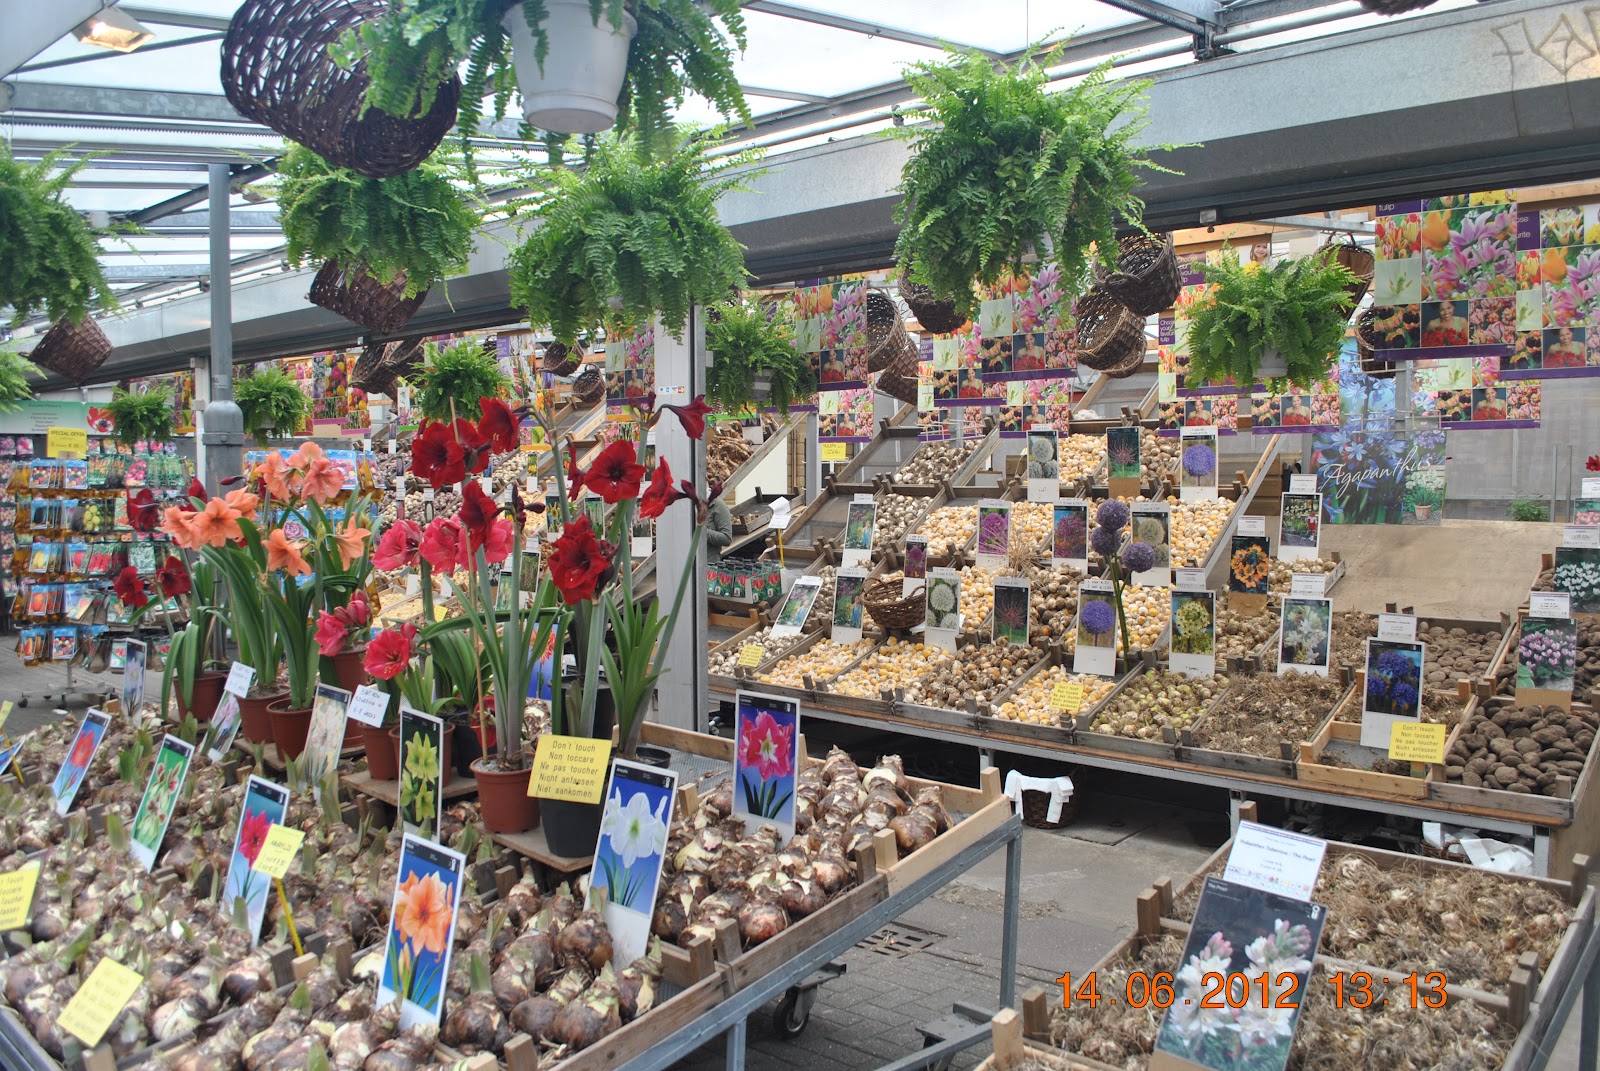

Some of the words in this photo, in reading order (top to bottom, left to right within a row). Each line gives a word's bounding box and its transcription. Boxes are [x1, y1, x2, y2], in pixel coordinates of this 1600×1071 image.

[1318, 445, 1433, 500] Agapanthus
[552, 741, 572, 750] Don't
[576, 742, 596, 752] touch
[549, 752, 563, 760] Non
[567, 753, 594, 763] toccare
[540, 762, 550, 770] Ne
[553, 764, 566, 773] pas
[570, 765, 598, 775] toucher
[540, 773, 558, 782] Nicht
[561, 775, 595, 786] anfassen
[537, 784, 551, 793] Niet
[555, 786, 593, 798] aankomen
